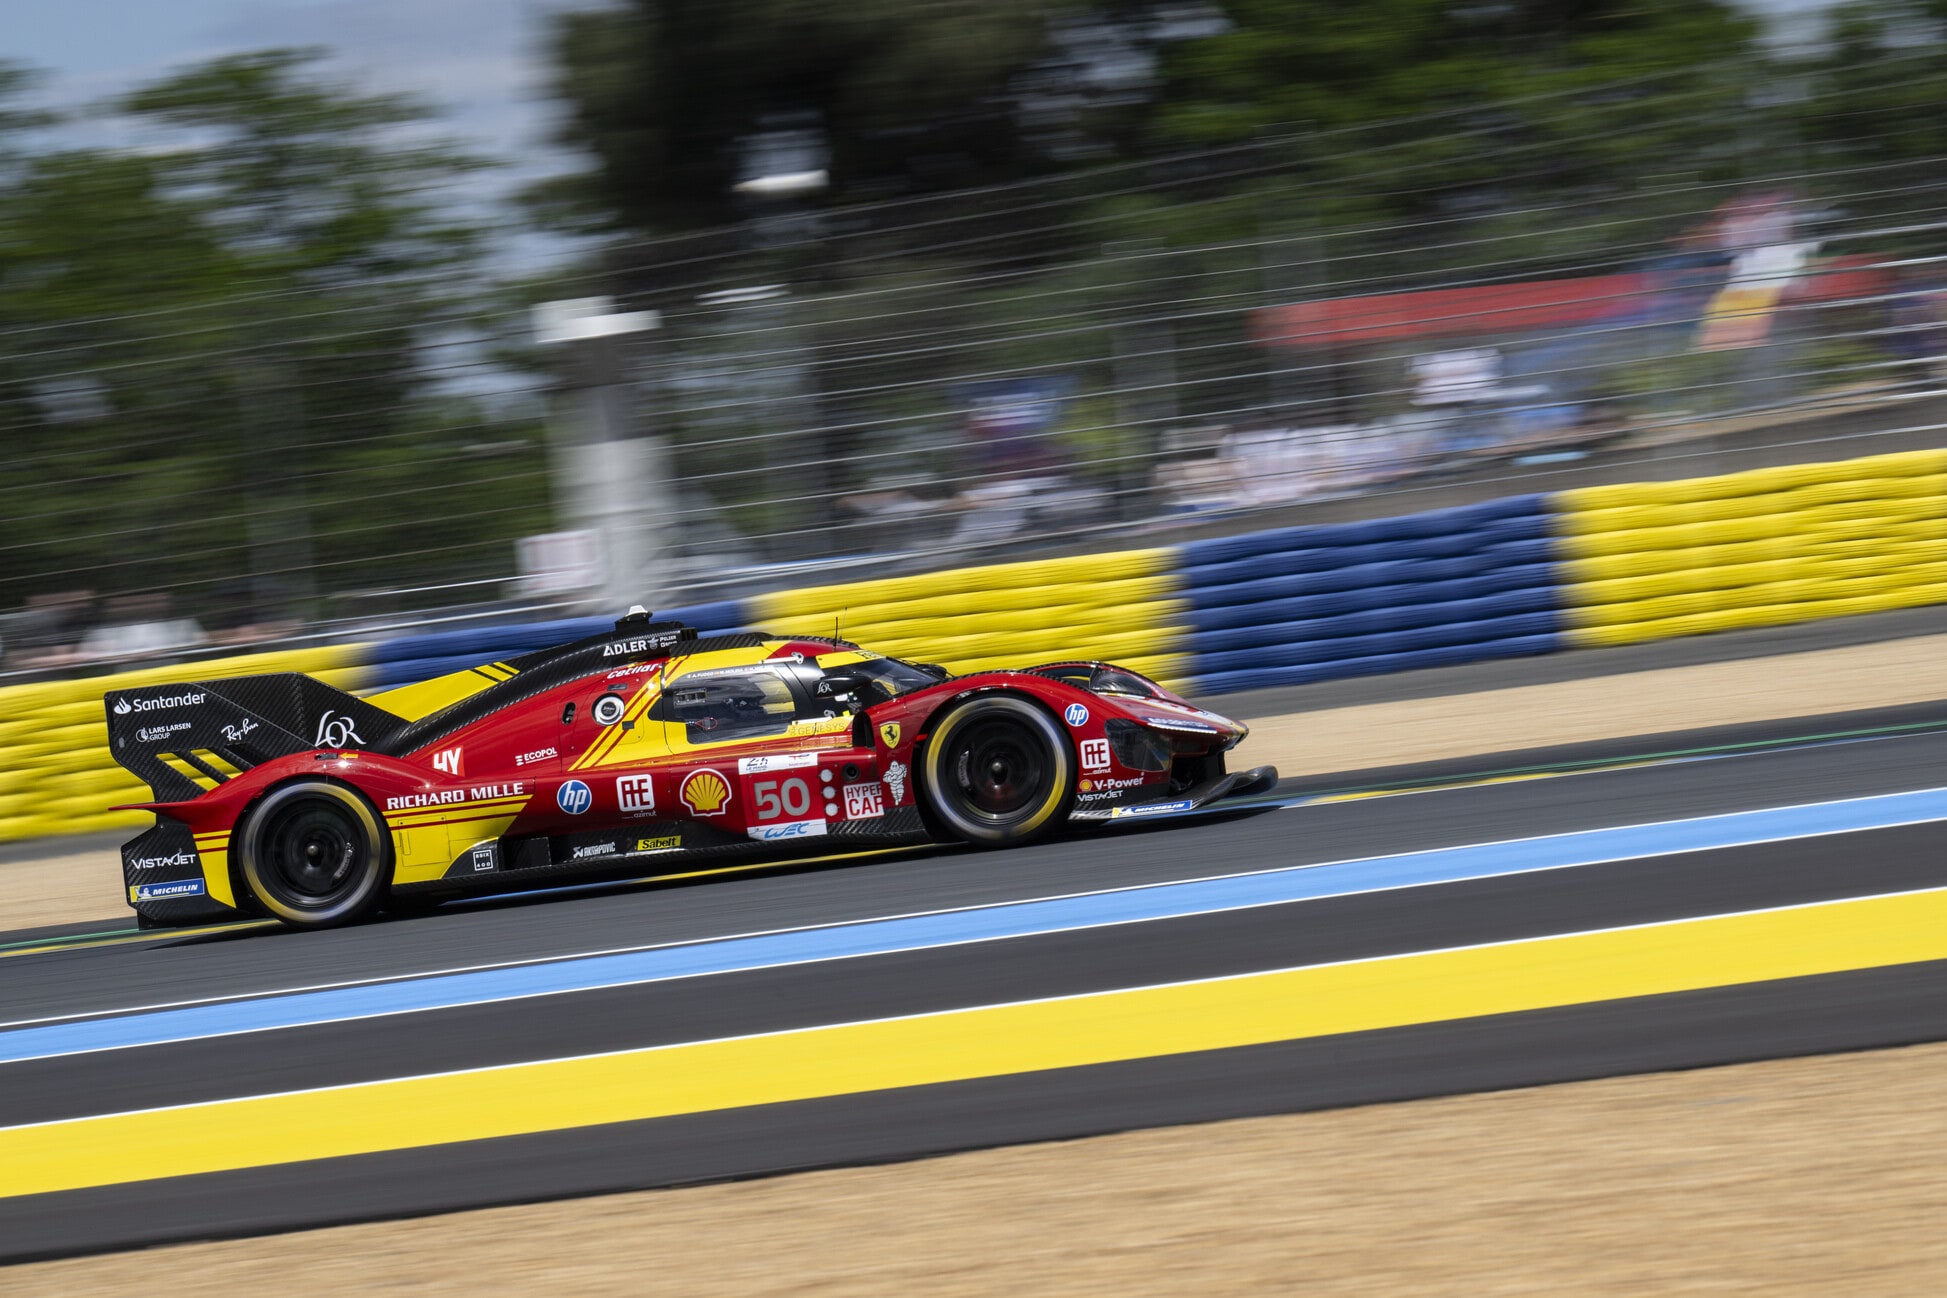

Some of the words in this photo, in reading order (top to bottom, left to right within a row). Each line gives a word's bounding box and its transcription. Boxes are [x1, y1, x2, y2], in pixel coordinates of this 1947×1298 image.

[603, 641, 647, 656] ADLER
[133, 692, 206, 713] Santander
[1071, 703, 1087, 725] hp
[148, 726, 167, 734] LARS
[168, 722, 191, 732] LARSEN
[221, 718, 259, 742] Ray-Ban
[797, 723, 845, 736] GENESYS
[150, 732, 171, 741] GROUP
[524, 747, 557, 761] ECOPOL
[1093, 777, 1144, 791] V-Power
[387, 789, 465, 810] RICHARD
[471, 782, 524, 800] MILLE
[562, 784, 588, 815] hp
[753, 777, 811, 820] 50
[633, 810, 657, 819] azimut
[1135, 803, 1185, 812] MICHELIN
[642, 837, 676, 849] Sabelt
[131, 848, 196, 869] VISTAJET
[152, 883, 198, 896] MICHELIN
